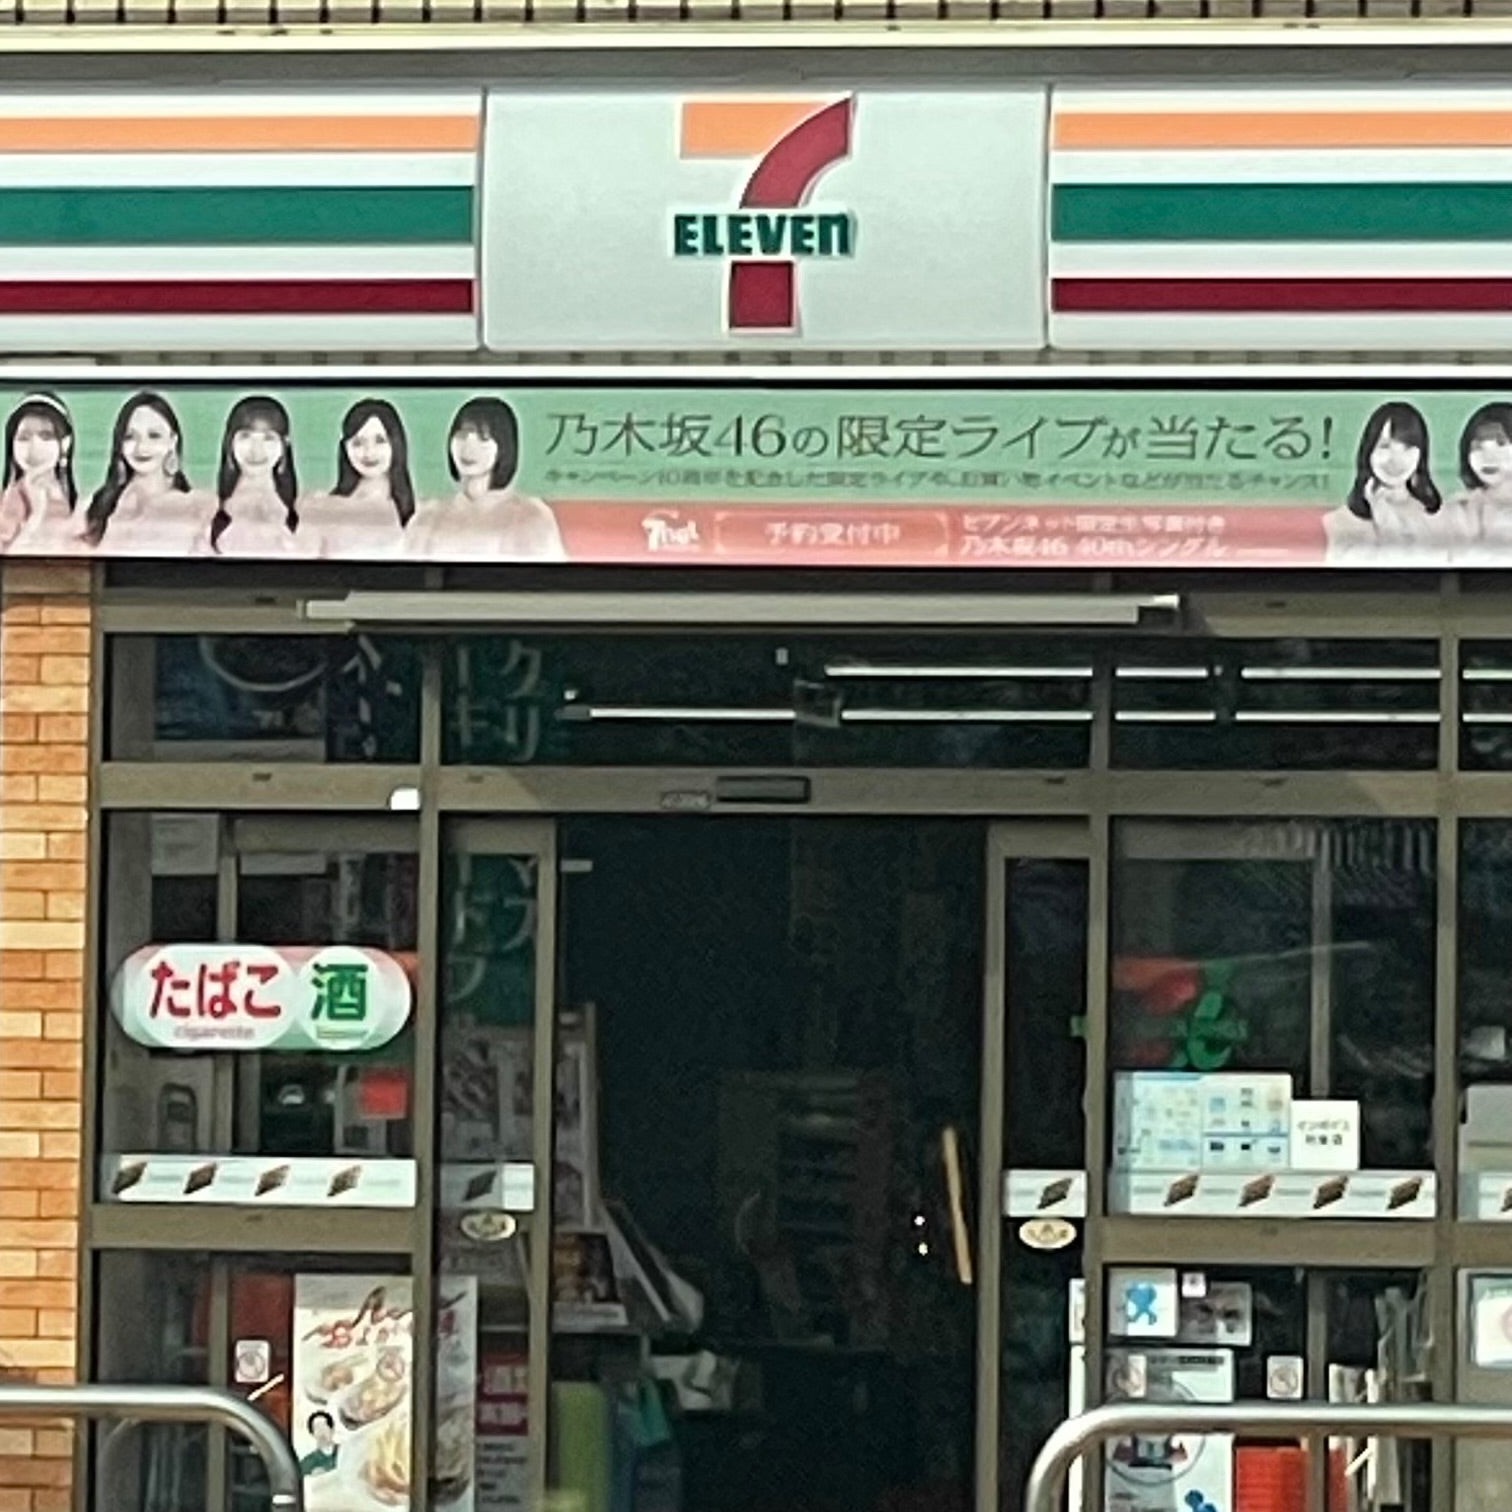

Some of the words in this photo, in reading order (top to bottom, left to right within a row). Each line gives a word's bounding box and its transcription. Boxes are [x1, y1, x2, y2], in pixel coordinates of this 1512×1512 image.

[149, 961, 282, 1018] たばこ
[311, 963, 369, 1020] 酒
